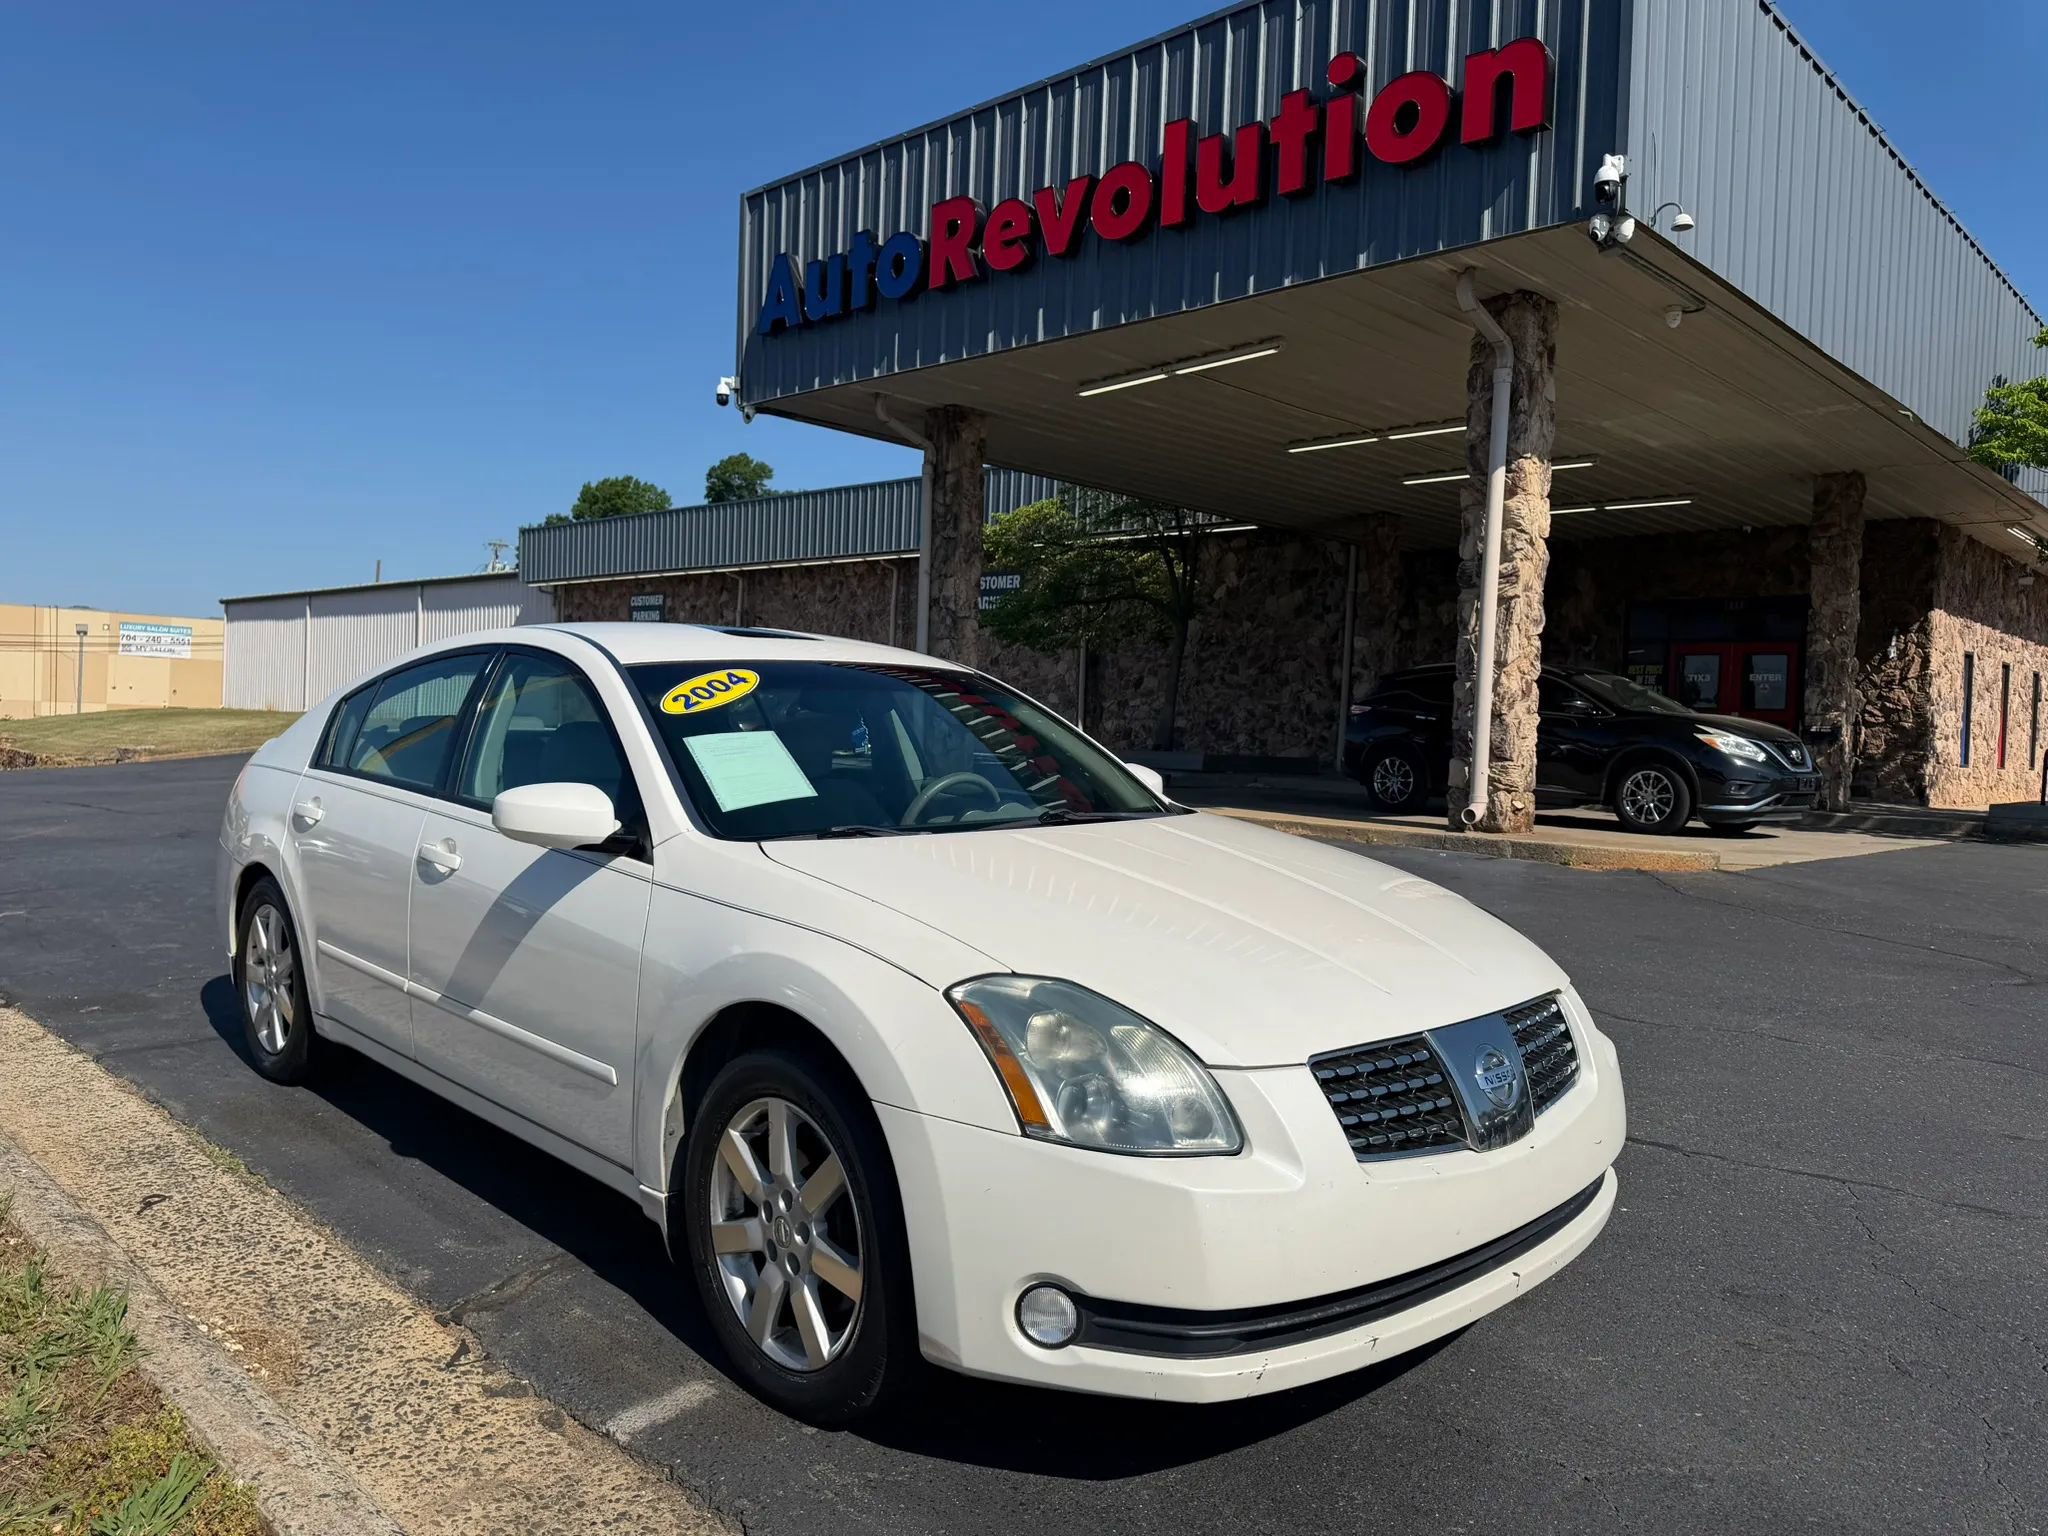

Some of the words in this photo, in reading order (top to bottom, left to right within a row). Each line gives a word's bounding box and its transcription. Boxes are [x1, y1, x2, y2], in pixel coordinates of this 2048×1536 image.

[756, 36, 1552, 337] AutoRevolution
[979, 574, 1021, 590] STOMER
[630, 594, 664, 607] CUSTOMER
[632, 610, 661, 622] PARKING
[120, 623, 145, 632] LUXURY
[147, 625, 169, 633] SALON
[120, 634, 137, 642] 704
[1749, 673, 1783, 681] ENTER
[671, 671, 750, 711] 2004
